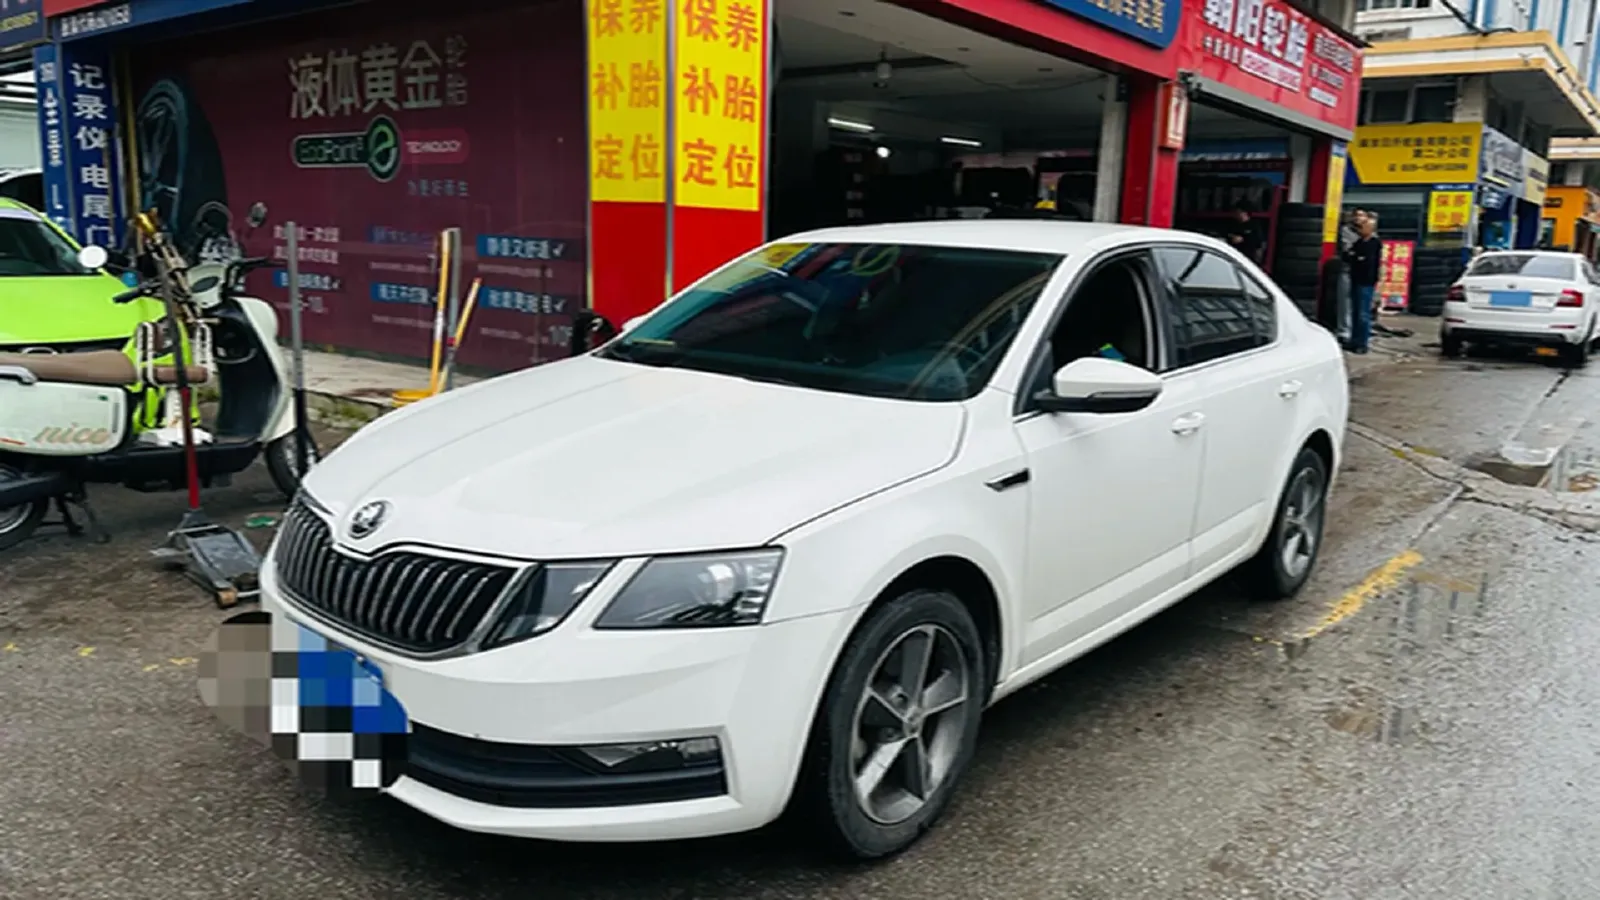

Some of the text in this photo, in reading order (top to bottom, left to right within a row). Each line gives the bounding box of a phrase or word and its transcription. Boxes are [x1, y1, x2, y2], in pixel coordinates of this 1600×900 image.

[592, 0, 662, 37] 保养
[683, 0, 758, 52] 保养
[1203, 0, 1309, 68] 朝阳轮胎
[288, 40, 442, 118] 液体黄金
[445, 35, 468, 106] 轮胎
[592, 60, 662, 110] 补胎
[682, 64, 758, 123] 补胎
[69, 63, 108, 150] 记录仪
[593, 133, 661, 181] 定位
[682, 137, 756, 189] 定位
[80, 164, 116, 248] 电尾门
